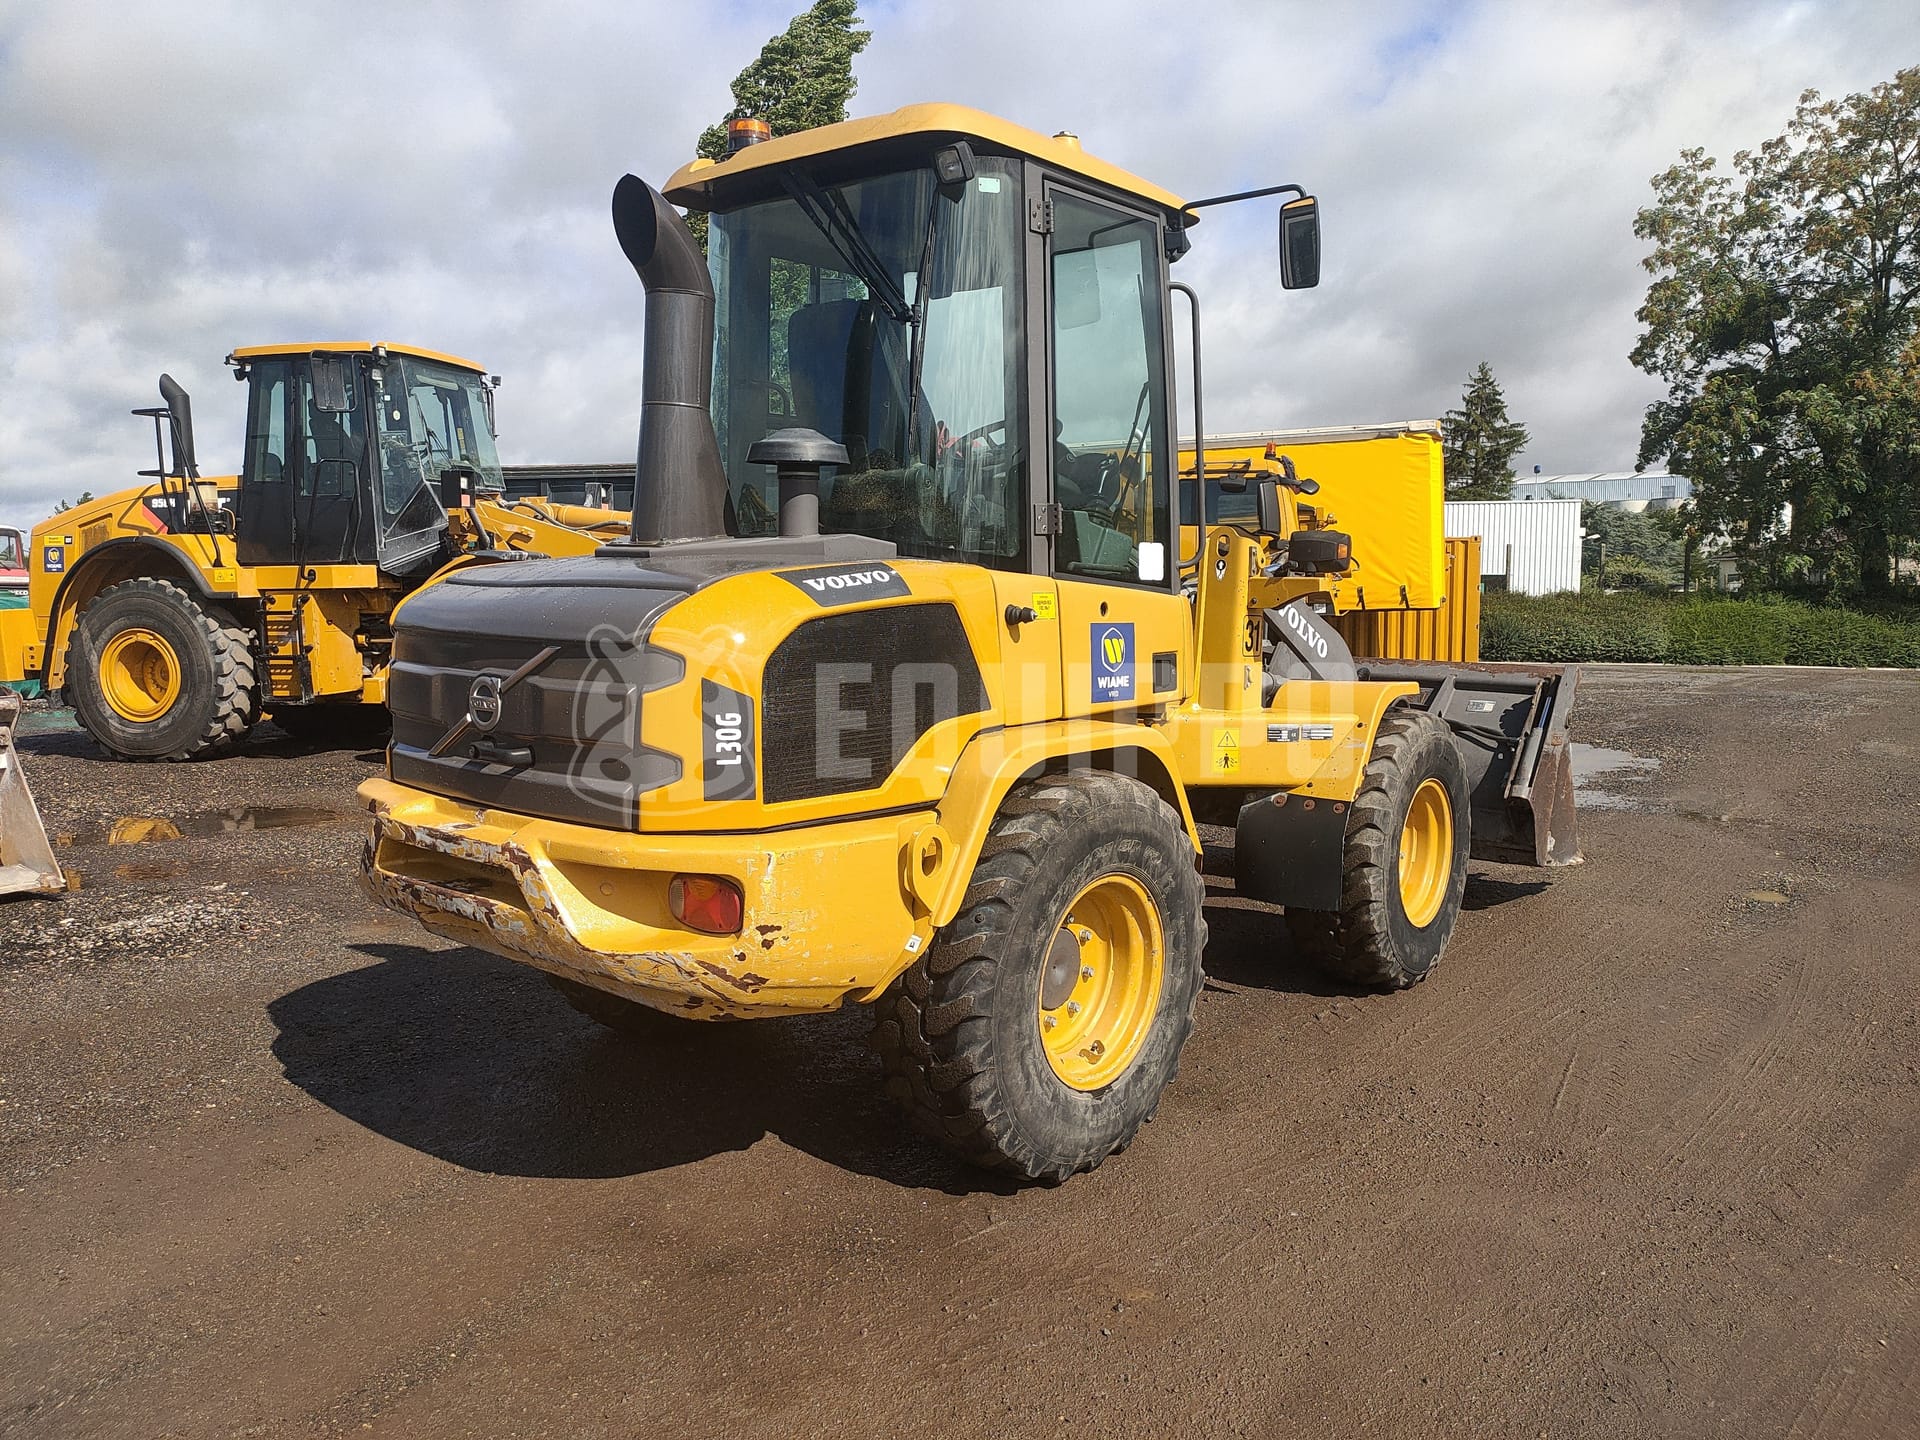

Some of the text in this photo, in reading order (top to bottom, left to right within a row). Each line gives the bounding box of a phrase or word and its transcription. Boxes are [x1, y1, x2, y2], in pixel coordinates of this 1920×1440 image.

[803, 570, 890, 591] VOLVO
[1245, 619, 1260, 652] 31
[1278, 604, 1328, 658] VOLVO
[1098, 676, 1130, 689] WIAME
[715, 712, 742, 766] L30G
